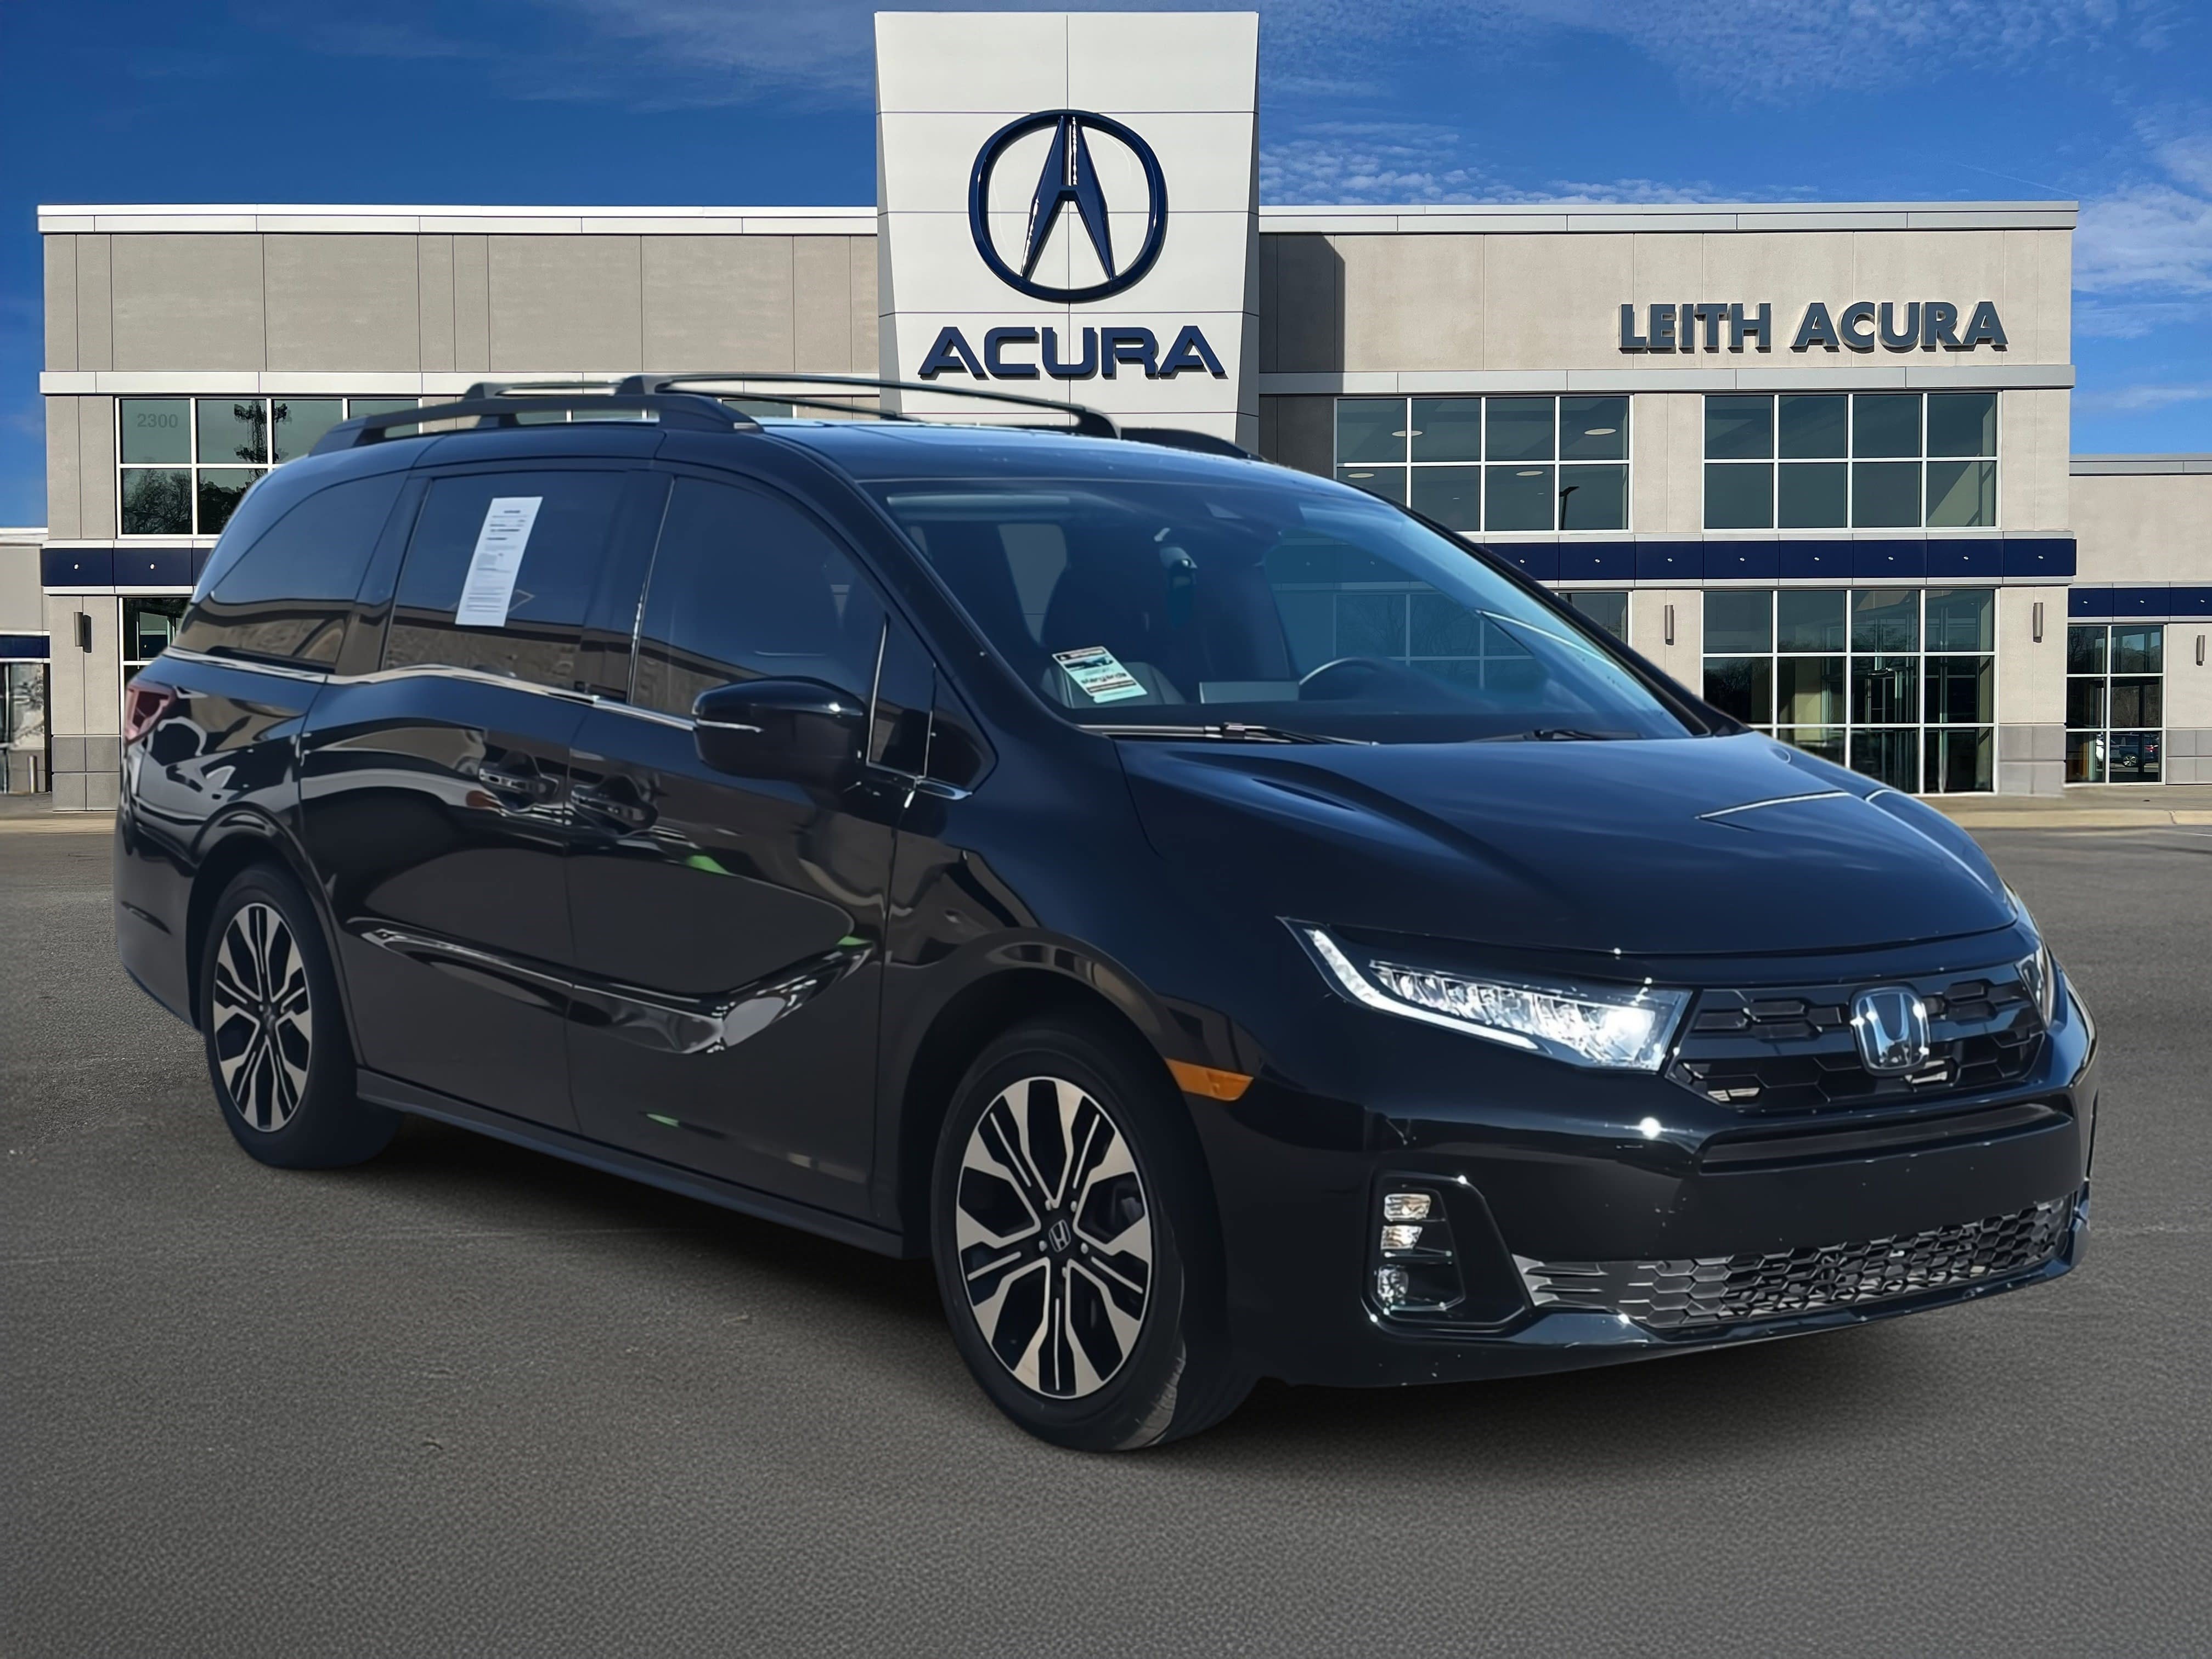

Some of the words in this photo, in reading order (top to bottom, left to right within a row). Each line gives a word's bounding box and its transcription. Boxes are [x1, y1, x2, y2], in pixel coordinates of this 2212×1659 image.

[918, 325, 1227, 379] ACURA
[1620, 303, 1771, 353] LEITH
[1790, 301, 2008, 353] ACURA
[137, 413, 178, 428] 2300
